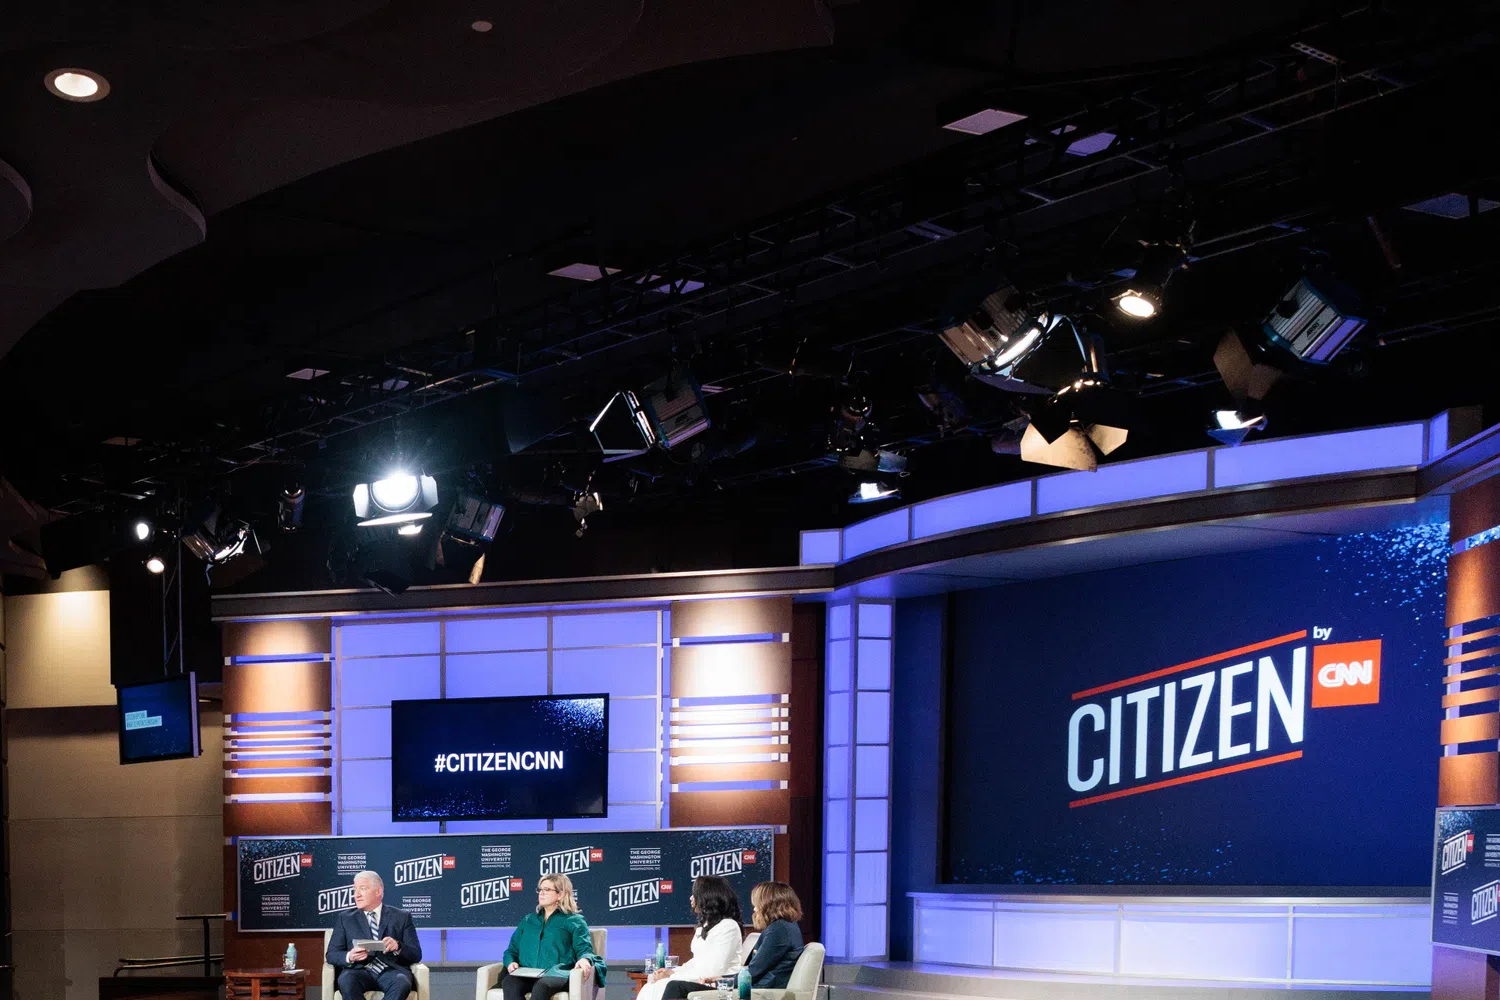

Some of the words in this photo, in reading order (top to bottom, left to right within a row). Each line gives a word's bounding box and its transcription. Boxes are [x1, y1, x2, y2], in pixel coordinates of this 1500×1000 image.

[1313, 626, 1332, 640] by
[1317, 660, 1373, 688] CNN
[1067, 646, 1307, 792] CITIZEN
[434, 751, 564, 772] #CITIZENCNN
[540, 849, 590, 876] CITIZEN
[691, 851, 742, 879] CITIZEN
[1442, 834, 1467, 871] CITIZEN
[254, 855, 300, 881] CITIZEN
[394, 857, 442, 883] CITIZEN
[318, 887, 355, 911] CITIZE
[461, 878, 510, 905] CITIZEN
[609, 881, 659, 908] CITIZEN
[1471, 884, 1498, 920] CITIZEN
